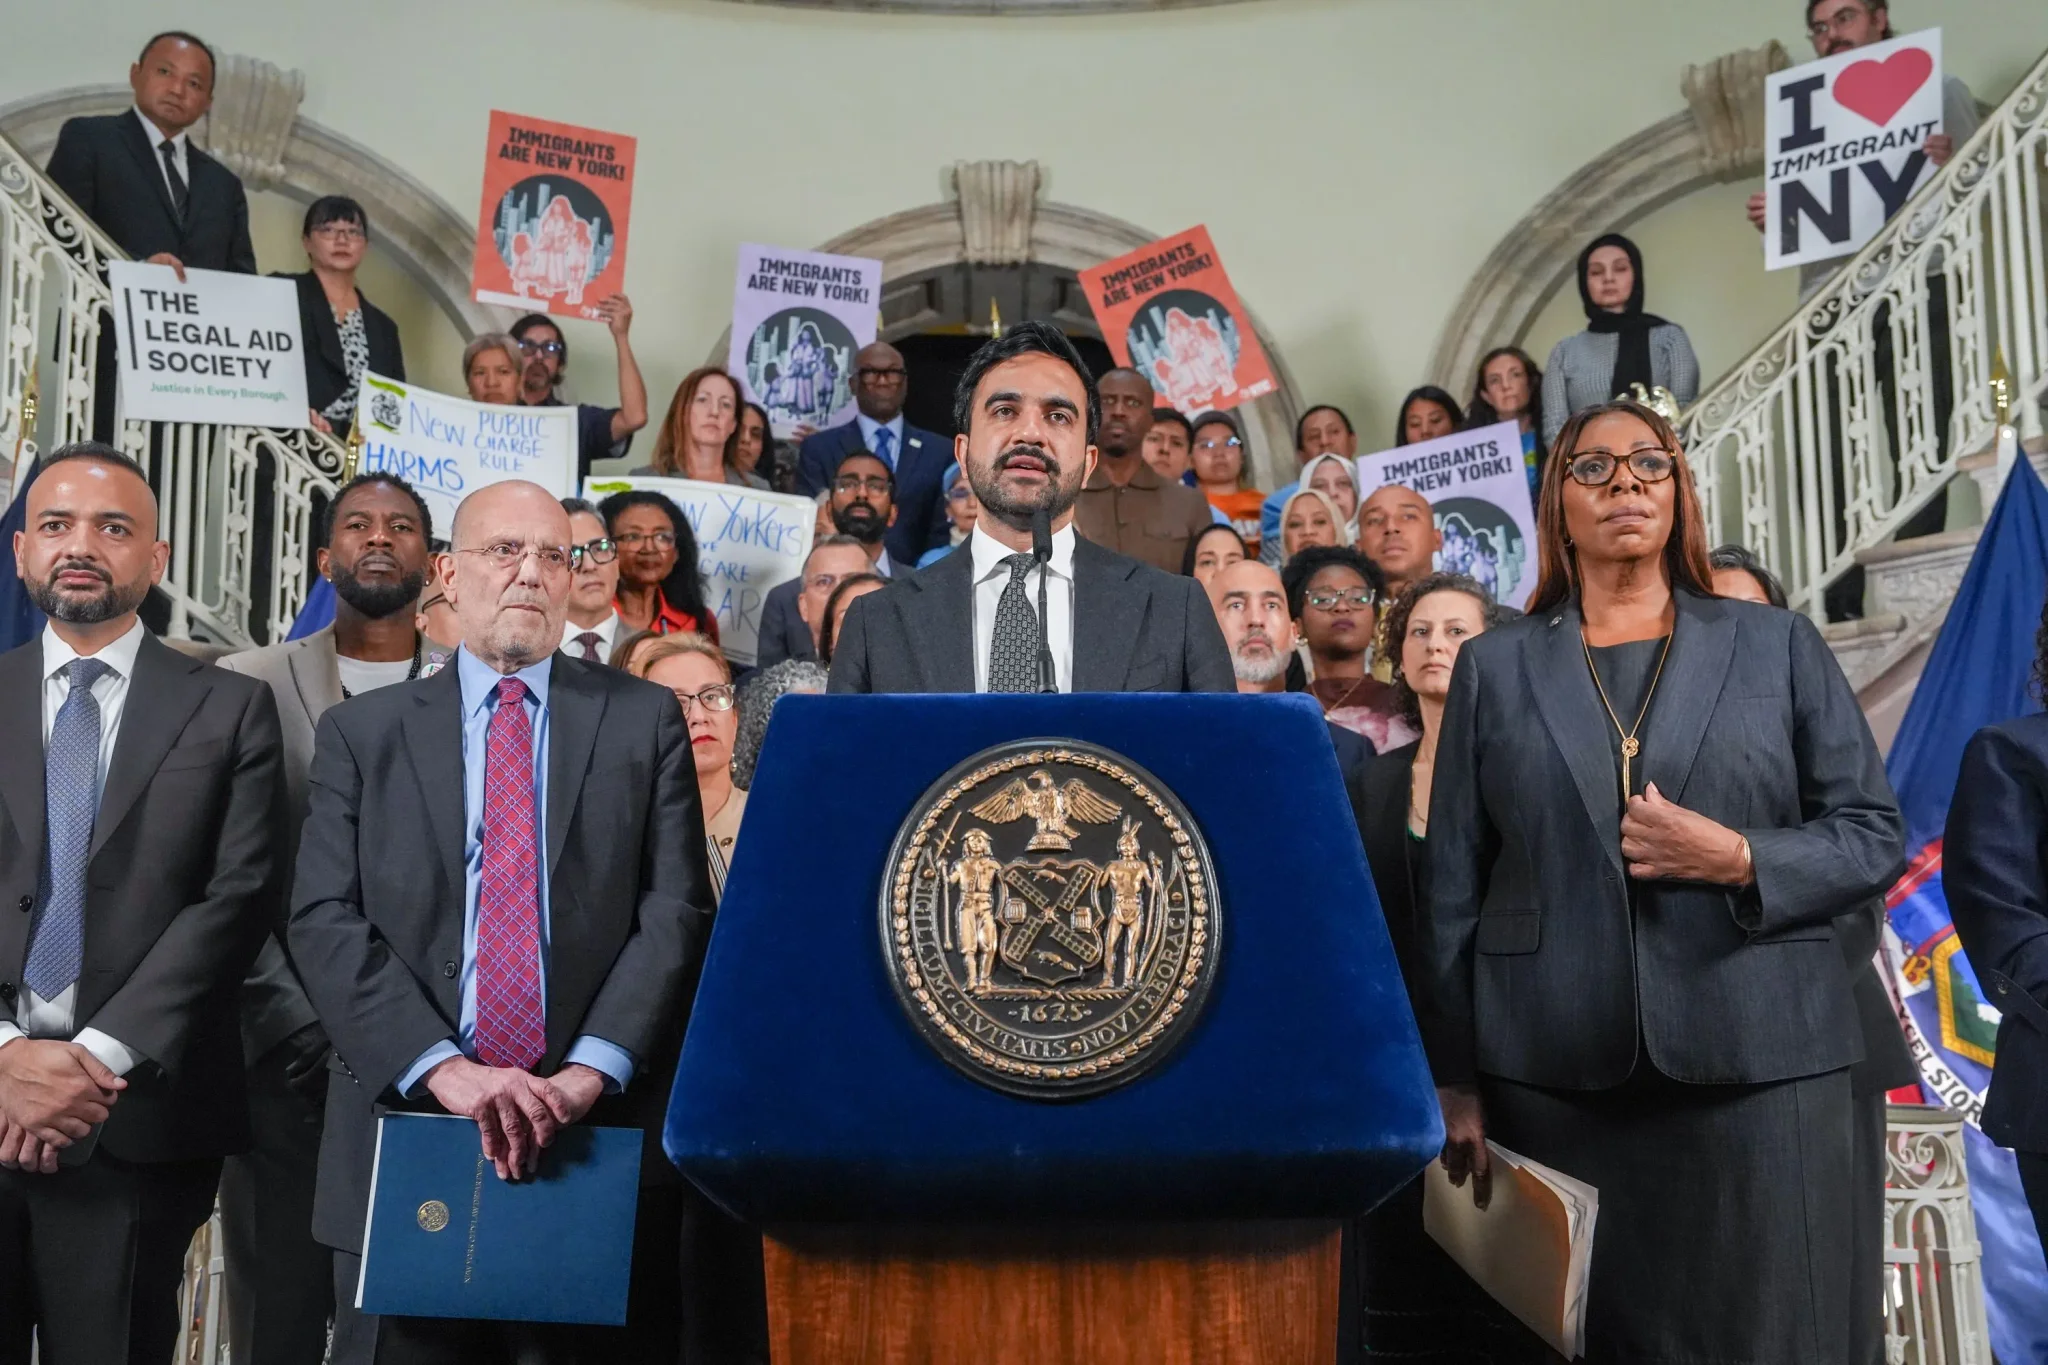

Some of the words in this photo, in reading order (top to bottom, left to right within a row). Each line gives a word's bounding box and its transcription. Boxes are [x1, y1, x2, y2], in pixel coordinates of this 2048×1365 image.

[1779, 73, 1825, 154] I
[508, 127, 615, 161] IMMIGRANTS
[1770, 120, 1939, 180] IMMIGRANT
[499, 143, 530, 164] ARE
[535, 148, 572, 171] NEW
[577, 158, 625, 181] YORK!
[1780, 149, 1930, 256] NY
[758, 258, 862, 285] IMMIGRANTS
[1101, 242, 1196, 291] IMMIGRANTS
[1103, 290, 1131, 309] ARE
[1132, 274, 1165, 296] NEW
[1168, 253, 1213, 281] YORK!
[140, 289, 199, 315] THE
[748, 274, 777, 292] ARE
[782, 279, 818, 297] NEW
[823, 284, 869, 304] YORK!
[145, 319, 240, 348] LEGAL
[248, 330, 293, 352] AID
[148, 350, 272, 379] SOCIETY
[149, 382, 191, 394] Justice
[193, 384, 204, 394] in
[207, 385, 237, 399] Every
[240, 389, 288, 402] Borough.
[479, 410, 549, 438] PUBLIC
[474, 433, 543, 459] CHARGE
[480, 450, 524, 472] RULE
[1382, 440, 1499, 482] IMMIGRANTS
[365, 442, 464, 491] HARMS
[1413, 470, 1453, 493] NEW
[1457, 456, 1513, 484] YORK!
[951, 1000, 1067, 1058] CIVITATIS
[1079, 1007, 1141, 1053] NOVI
[1142, 907, 1186, 1010] EBORACI
[1019, 1003, 1084, 1022] 1625
